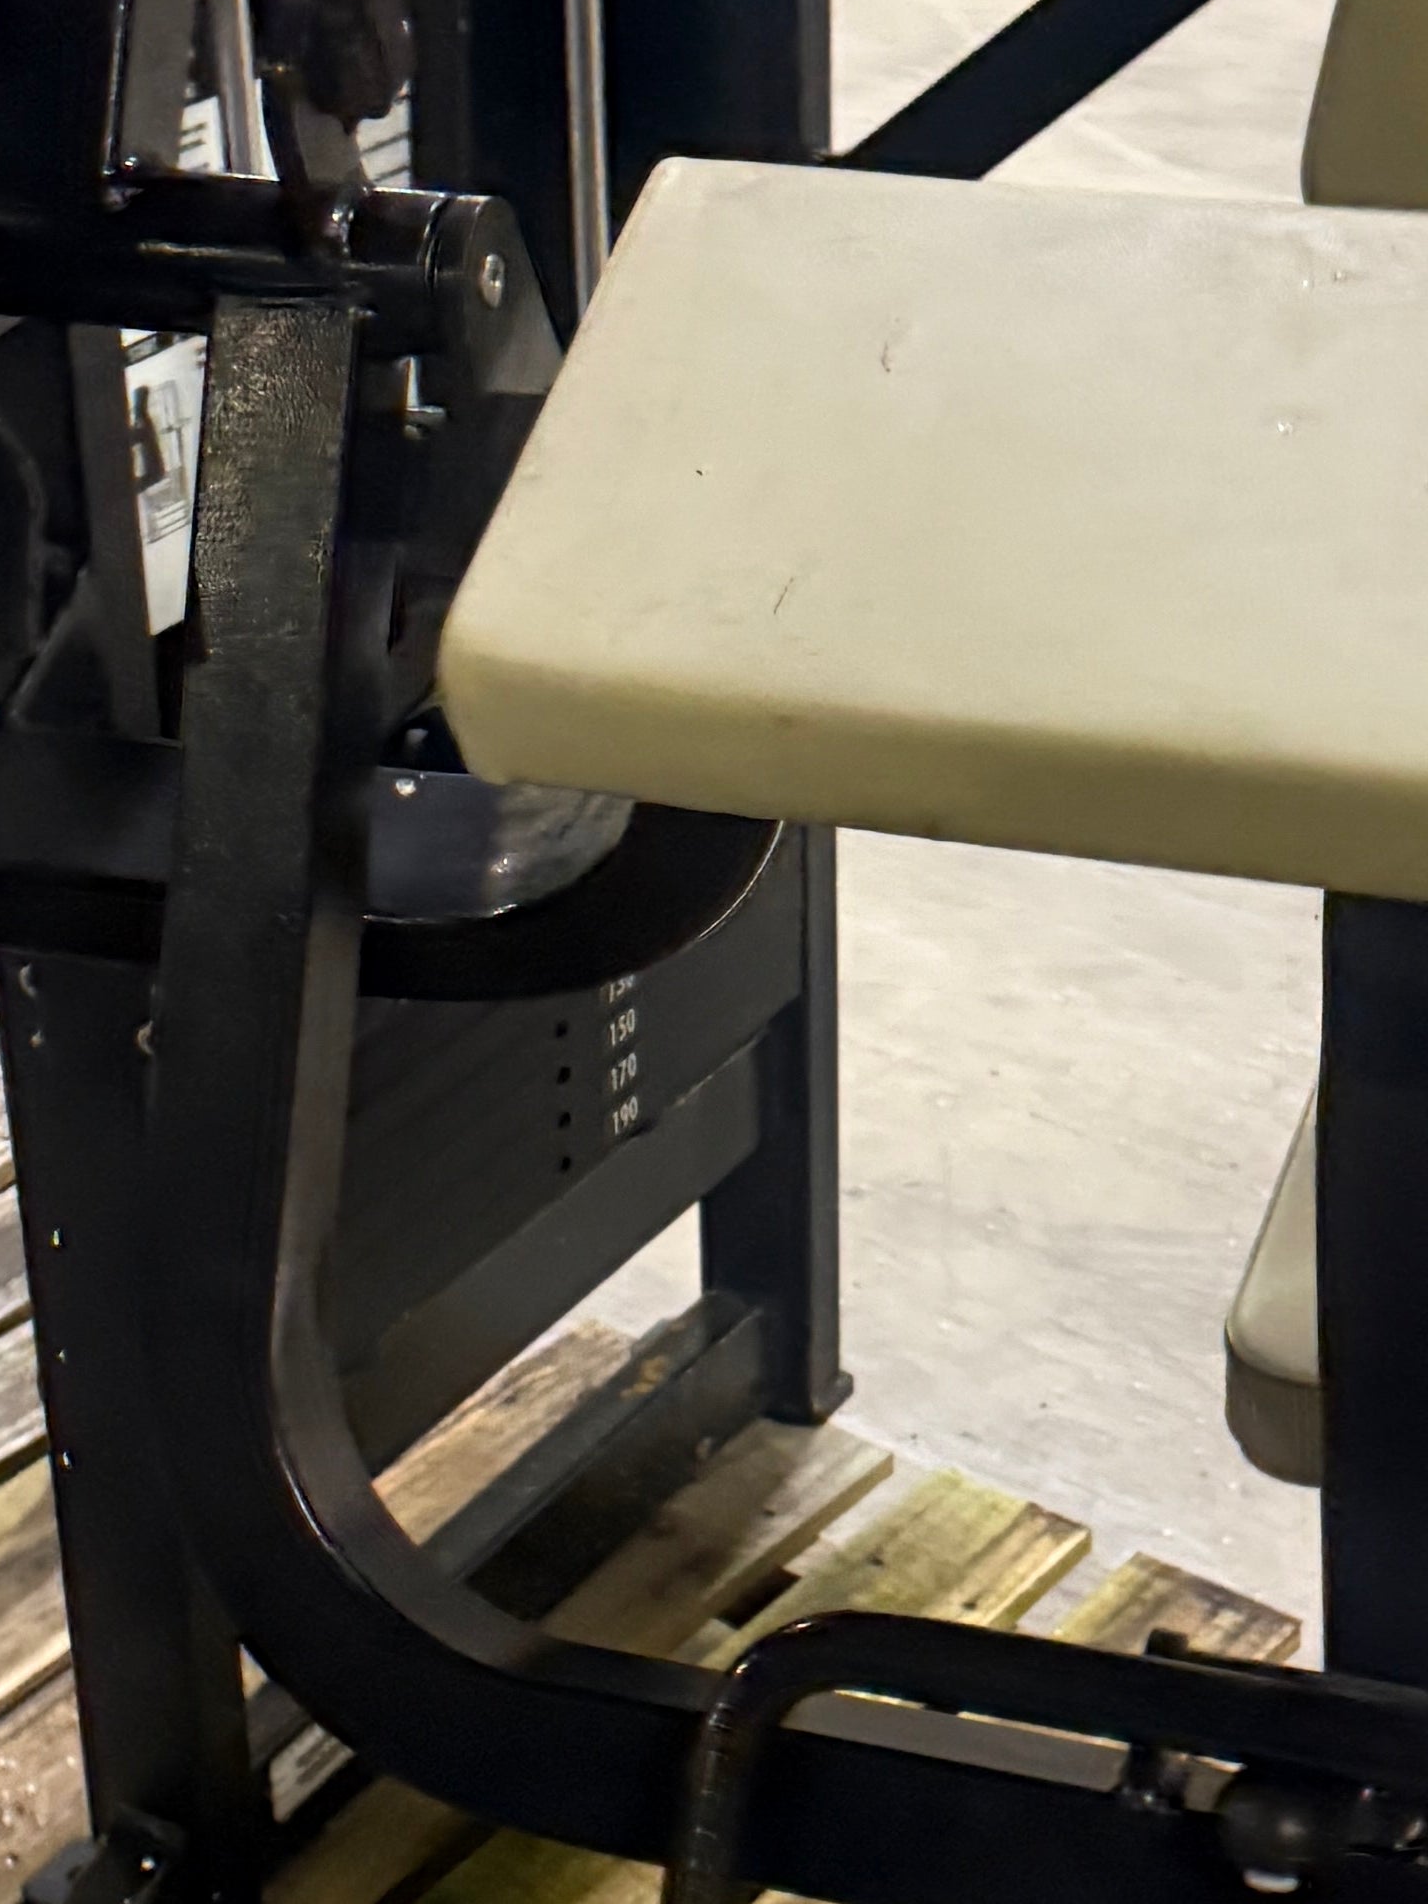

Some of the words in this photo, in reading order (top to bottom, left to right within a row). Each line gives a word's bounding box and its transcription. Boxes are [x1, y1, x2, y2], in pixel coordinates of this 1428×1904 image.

[609, 1008, 636, 1046] 150
[610, 1052, 638, 1091] 170
[612, 1095, 639, 1136] 190
